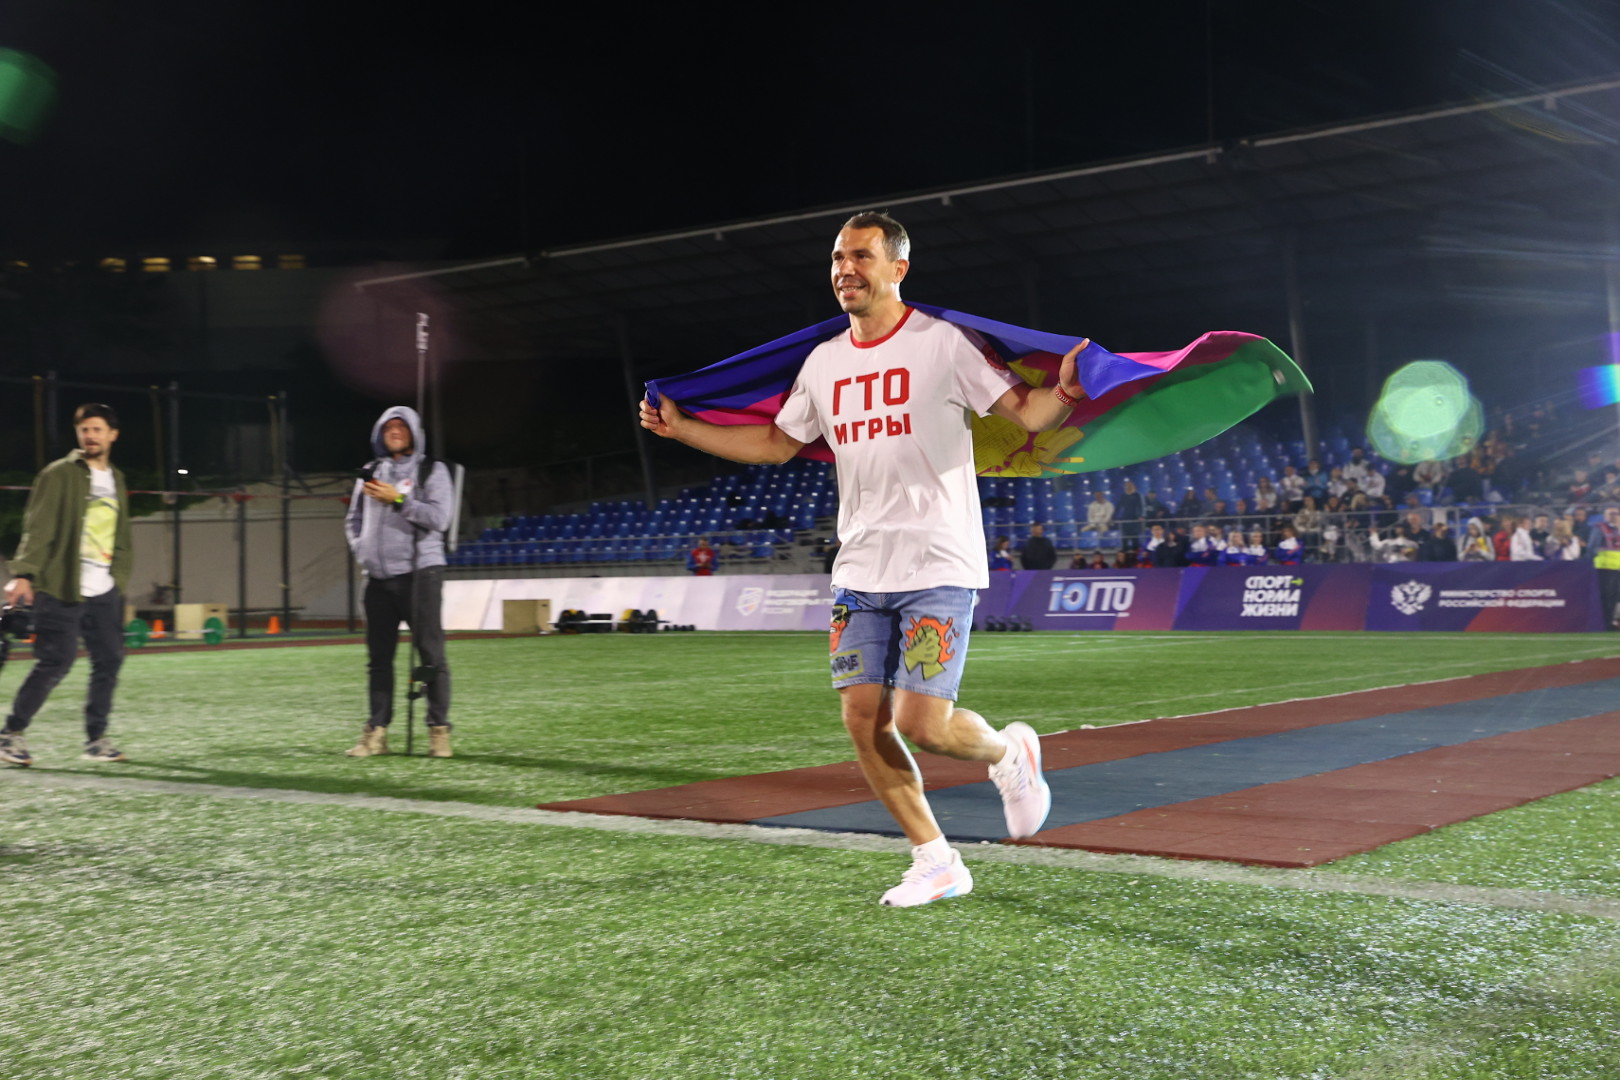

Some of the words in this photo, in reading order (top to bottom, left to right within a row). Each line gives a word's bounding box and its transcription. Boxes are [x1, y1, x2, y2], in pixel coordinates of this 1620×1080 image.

[832, 367, 910, 416] ГТО
[834, 413, 912, 445] ИГРЫ
[1245, 575, 1294, 589] СПОРТ
[1242, 589, 1301, 602] НОРМА
[1517, 589, 1556, 597] СПОРТА
[1240, 603, 1299, 617] ЖИЗНИ
